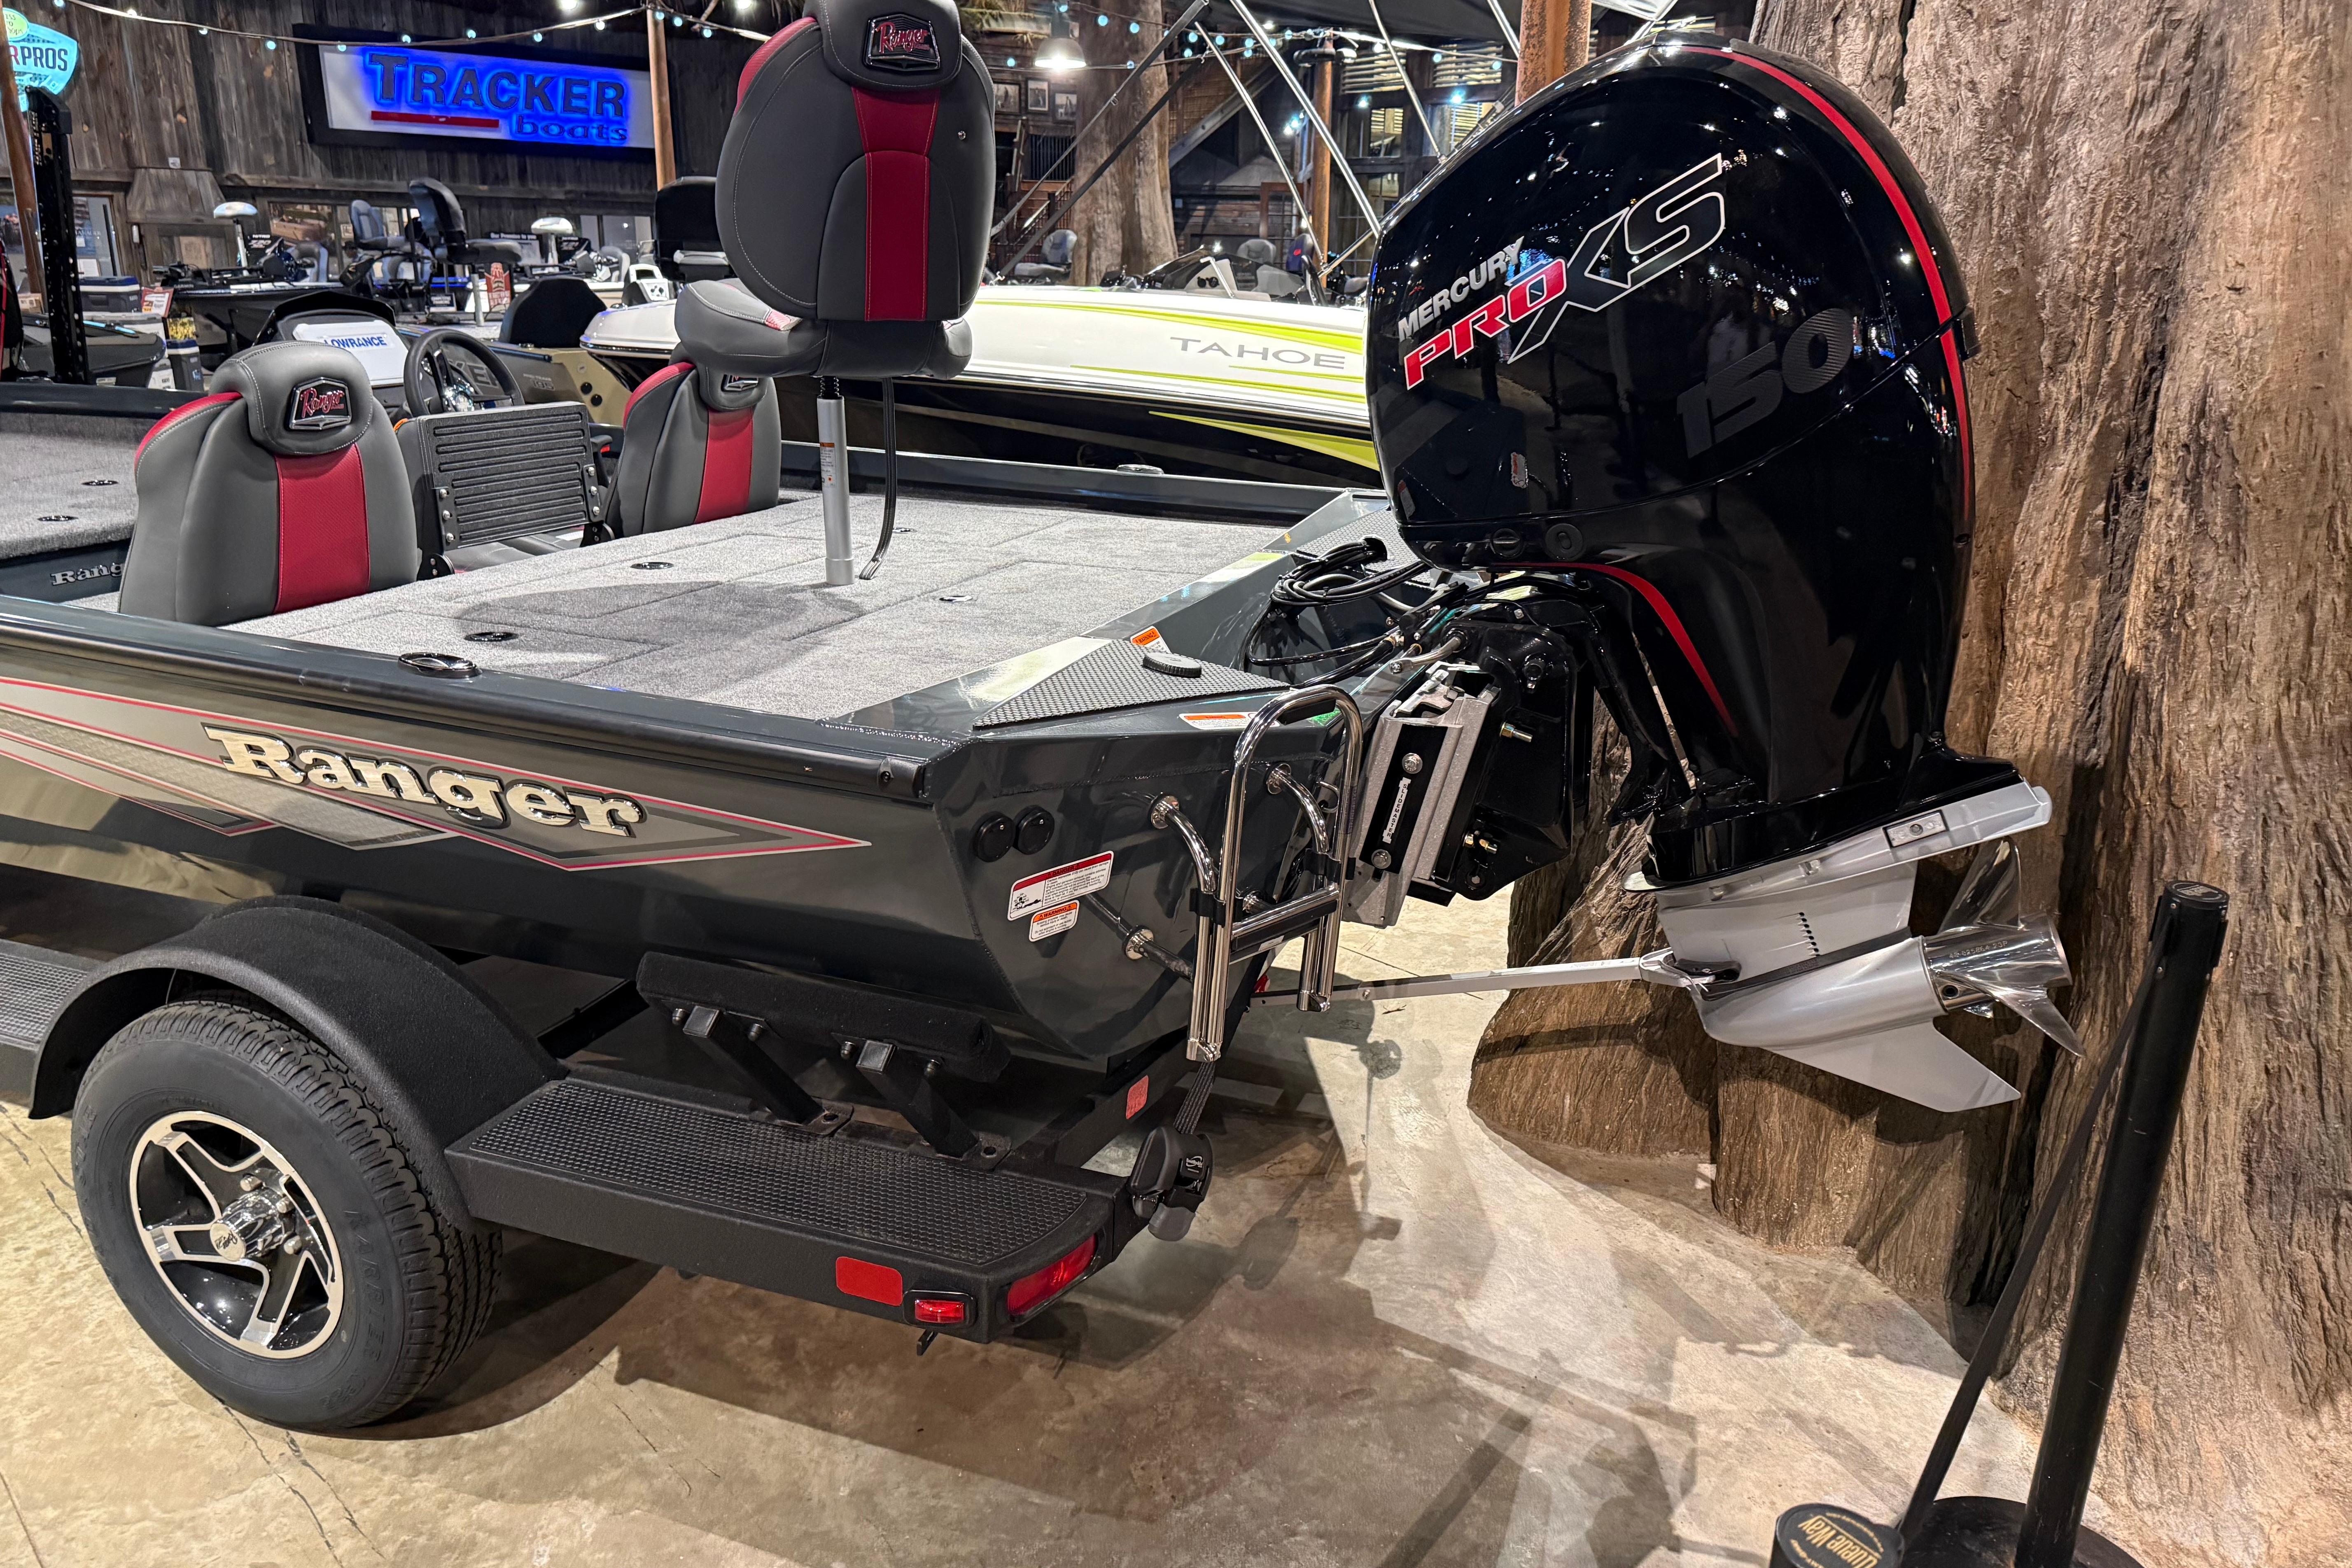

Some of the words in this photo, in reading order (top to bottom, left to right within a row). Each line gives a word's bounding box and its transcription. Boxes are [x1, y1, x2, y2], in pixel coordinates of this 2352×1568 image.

[875, 22, 930, 54] Ranger
[369, 54, 625, 117] TRACKER
[517, 114, 628, 141] boats
[1398, 236, 1524, 343] MERCURY
[324, 336, 387, 349] LOWRANCE
[1170, 336, 1345, 369] TAHOE
[1677, 308, 1853, 459] 150
[300, 387, 345, 418] Ranger
[50, 562, 124, 586] Rang
[202, 723, 645, 838] Ranger
[1386, 784, 1407, 838] SLIDEMASTER
[1052, 866, 1075, 876] DANGER
[1044, 907, 1067, 918] WARNING
[1798, 1519, 1837, 1548] Way
